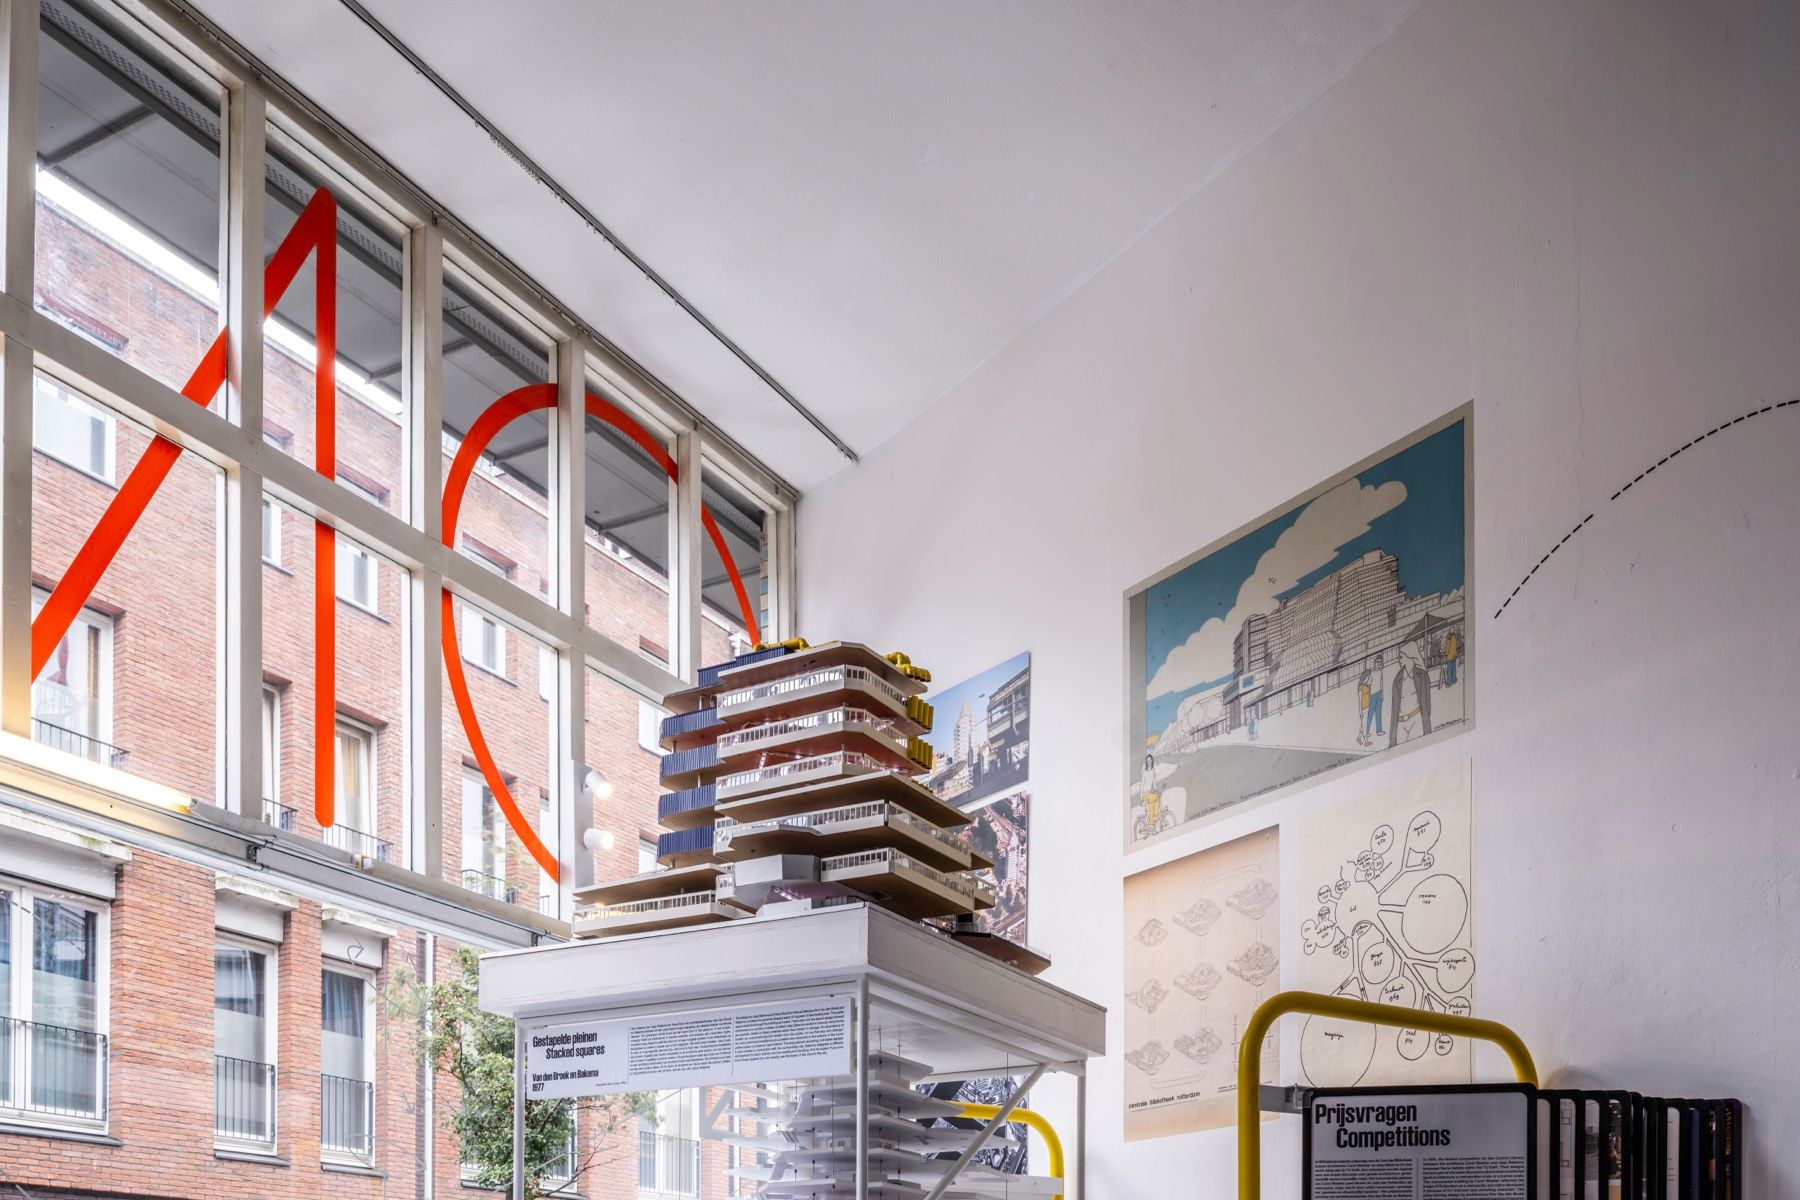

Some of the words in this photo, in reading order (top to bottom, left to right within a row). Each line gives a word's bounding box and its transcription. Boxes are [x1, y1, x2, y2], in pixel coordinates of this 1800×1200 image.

[532, 1033, 572, 1048] Gestapelde
[572, 1032, 597, 1046] pleinen
[546, 1047, 575, 1060] Stacked
[575, 1045, 605, 1058] squares
[532, 1073, 542, 1082] Van
[543, 1072, 553, 1081] den
[553, 1070, 570, 1080] Broek
[570, 1071, 577, 1080] en
[532, 1082, 545, 1092] 1977
[1128, 1101, 1147, 1109] centrale
[1149, 1095, 1175, 1105] bibliotheek
[1176, 1091, 1201, 1100] rotterdam
[1315, 1103, 1417, 1127] Prijsvragen
[1336, 1126, 1451, 1151] Competitions
